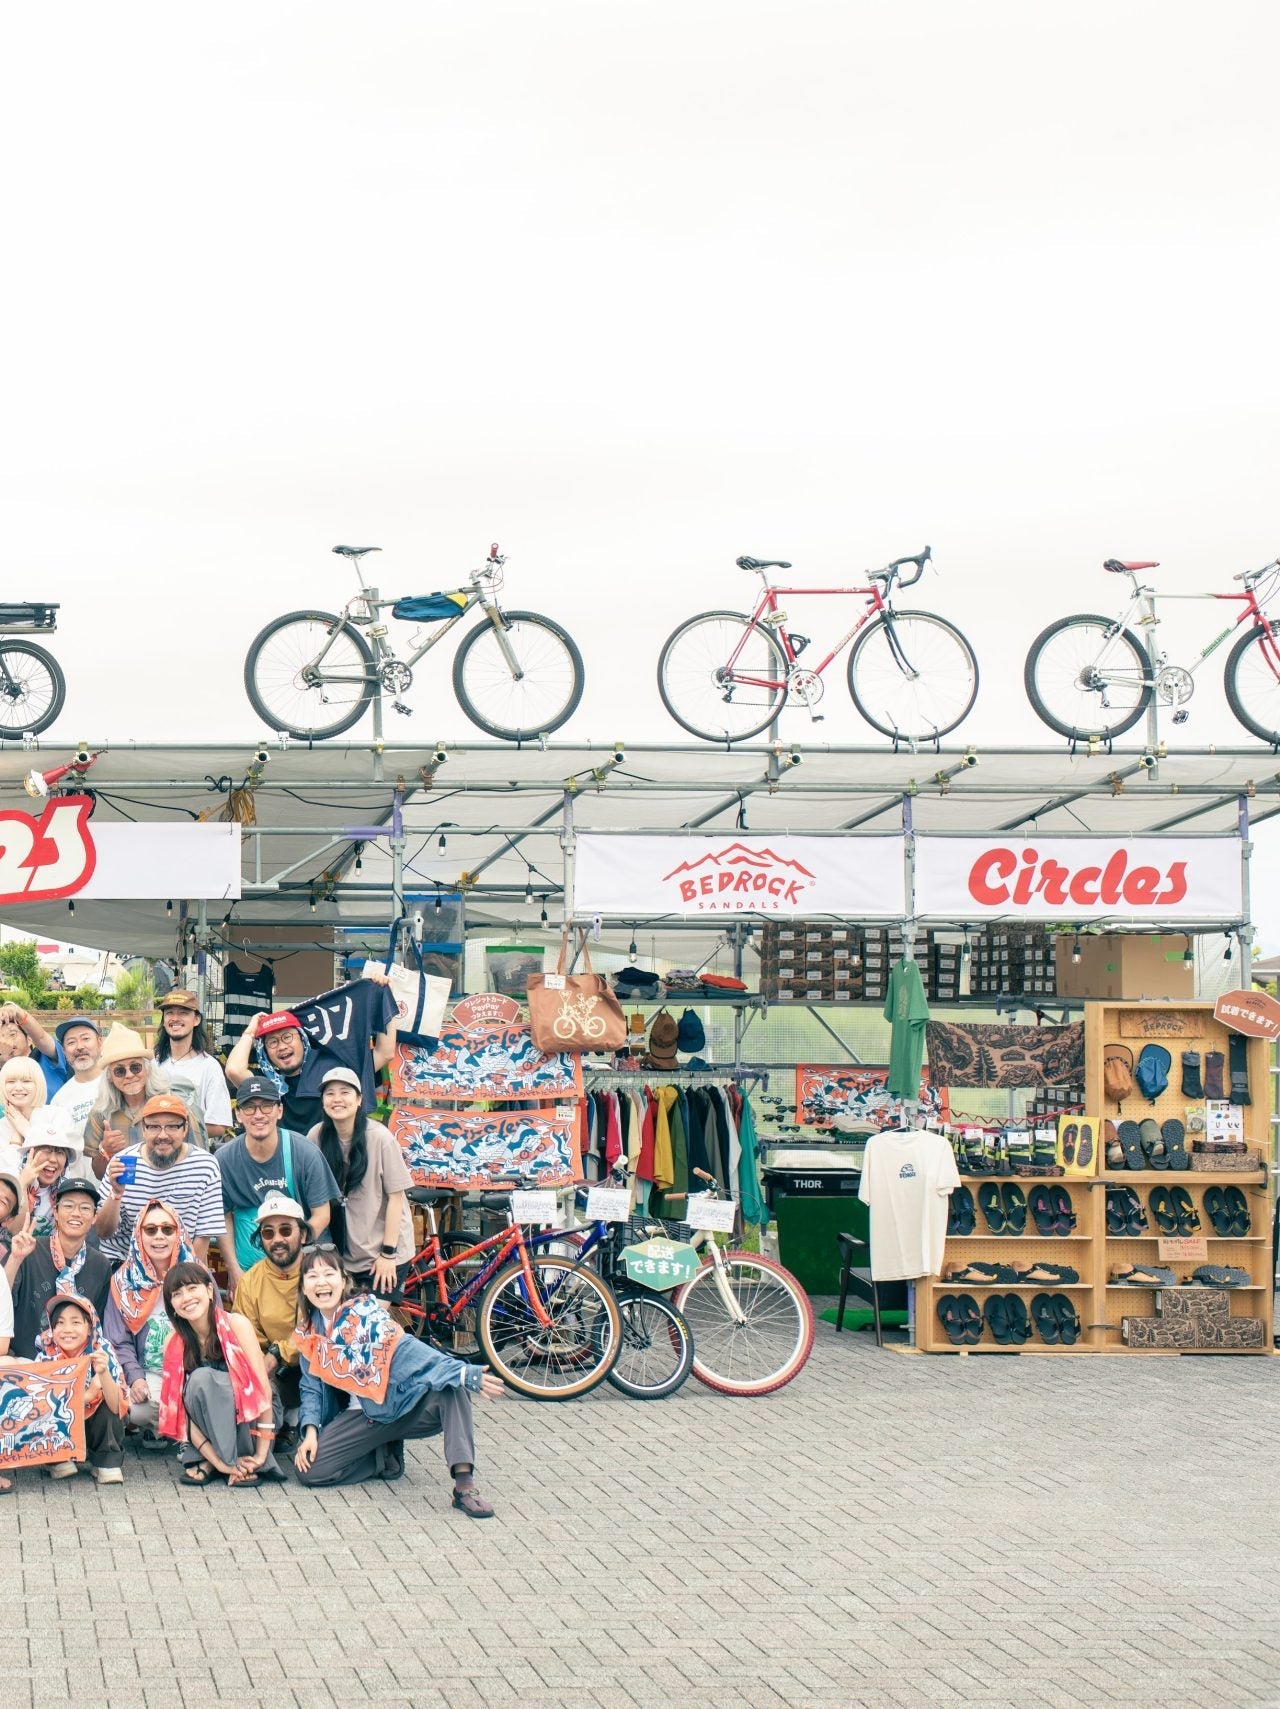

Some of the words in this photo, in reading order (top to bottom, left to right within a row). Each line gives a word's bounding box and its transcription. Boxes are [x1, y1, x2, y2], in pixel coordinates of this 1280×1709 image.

[968, 847, 1188, 906] Circles
[679, 870, 805, 905] BEDROCK
[698, 901, 779, 909] SANDALS
[471, 1003, 499, 1012] PayPay
[647, 1245, 674, 1259] 配送
